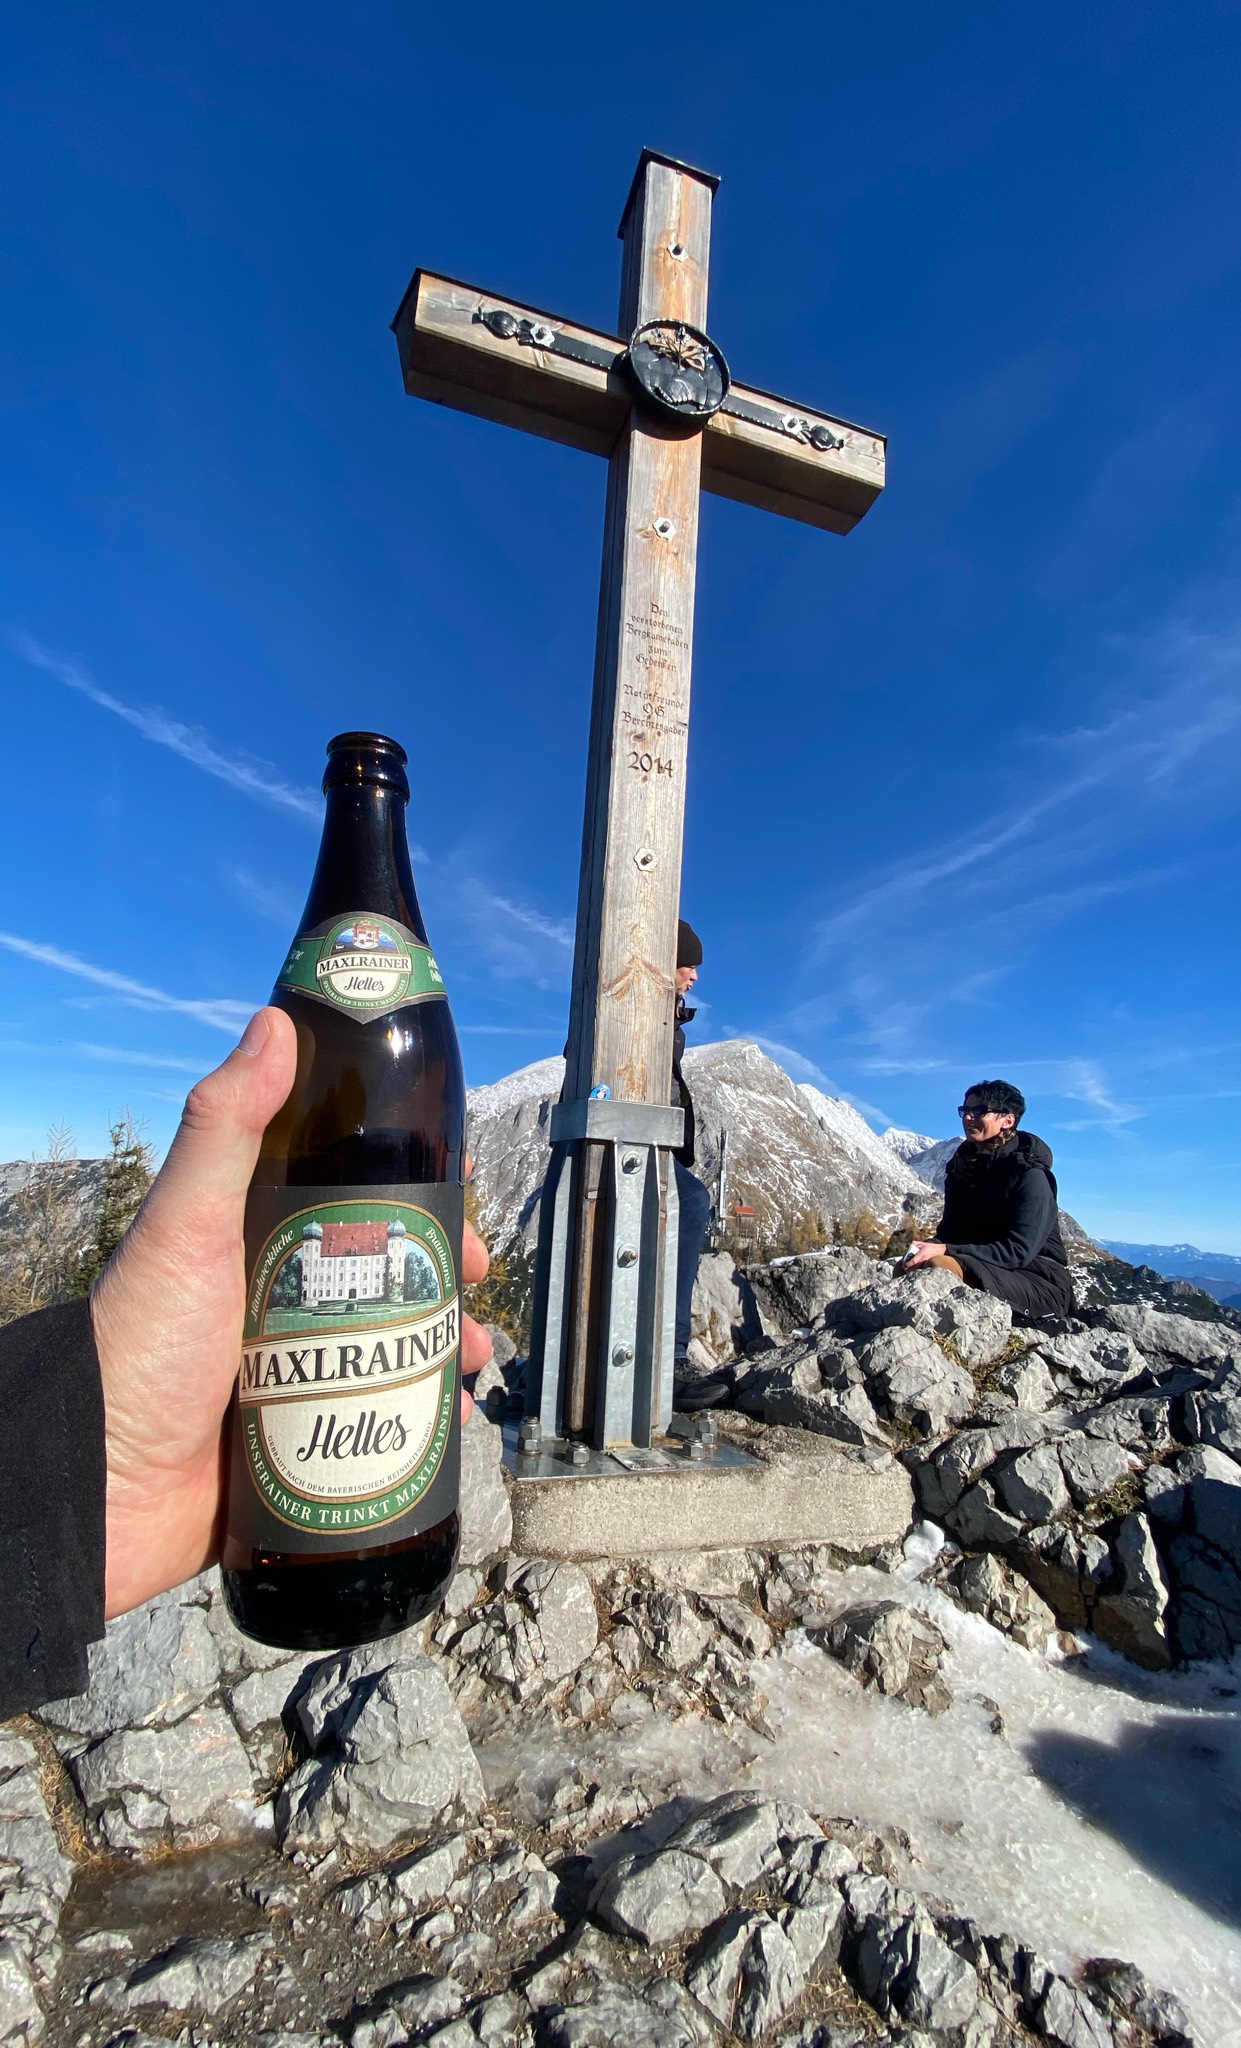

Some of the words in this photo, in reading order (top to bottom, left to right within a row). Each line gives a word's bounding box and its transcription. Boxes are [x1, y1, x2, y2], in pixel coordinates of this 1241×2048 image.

[651, 603, 668, 617] Den
[625, 622, 689, 650] Bergkameraden
[631, 615, 683, 635] verstorbenen
[635, 652, 677, 673] Gedenken
[623, 684, 684, 710] Naturfreunde
[626, 751, 673, 778] 2014
[319, 955, 410, 974] MAXLRAINER
[323, 980, 352, 1006] UNSERAINER
[380, 979, 406, 1004] MAXLRAINER
[344, 976, 385, 992] Helles
[250, 1229, 295, 1322] Handwerkliche
[424, 1226, 452, 1288] Braukunst
[241, 1307, 457, 1392] MAXLRAINER
[296, 1410, 412, 1462] Helles
[247, 1422, 312, 1521] UNSERAINER
[318, 1499, 390, 1524] TRINKT
[396, 1391, 452, 1508] MAXLRAINER
[267, 1435, 287, 1473] GEBRAUT
[285, 1470, 305, 1488] NACH
[307, 1482, 325, 1494] DEM
[327, 1478, 386, 1494] BAYERISCHEN
[387, 1420, 433, 1483] REINHEITSGEBOT
